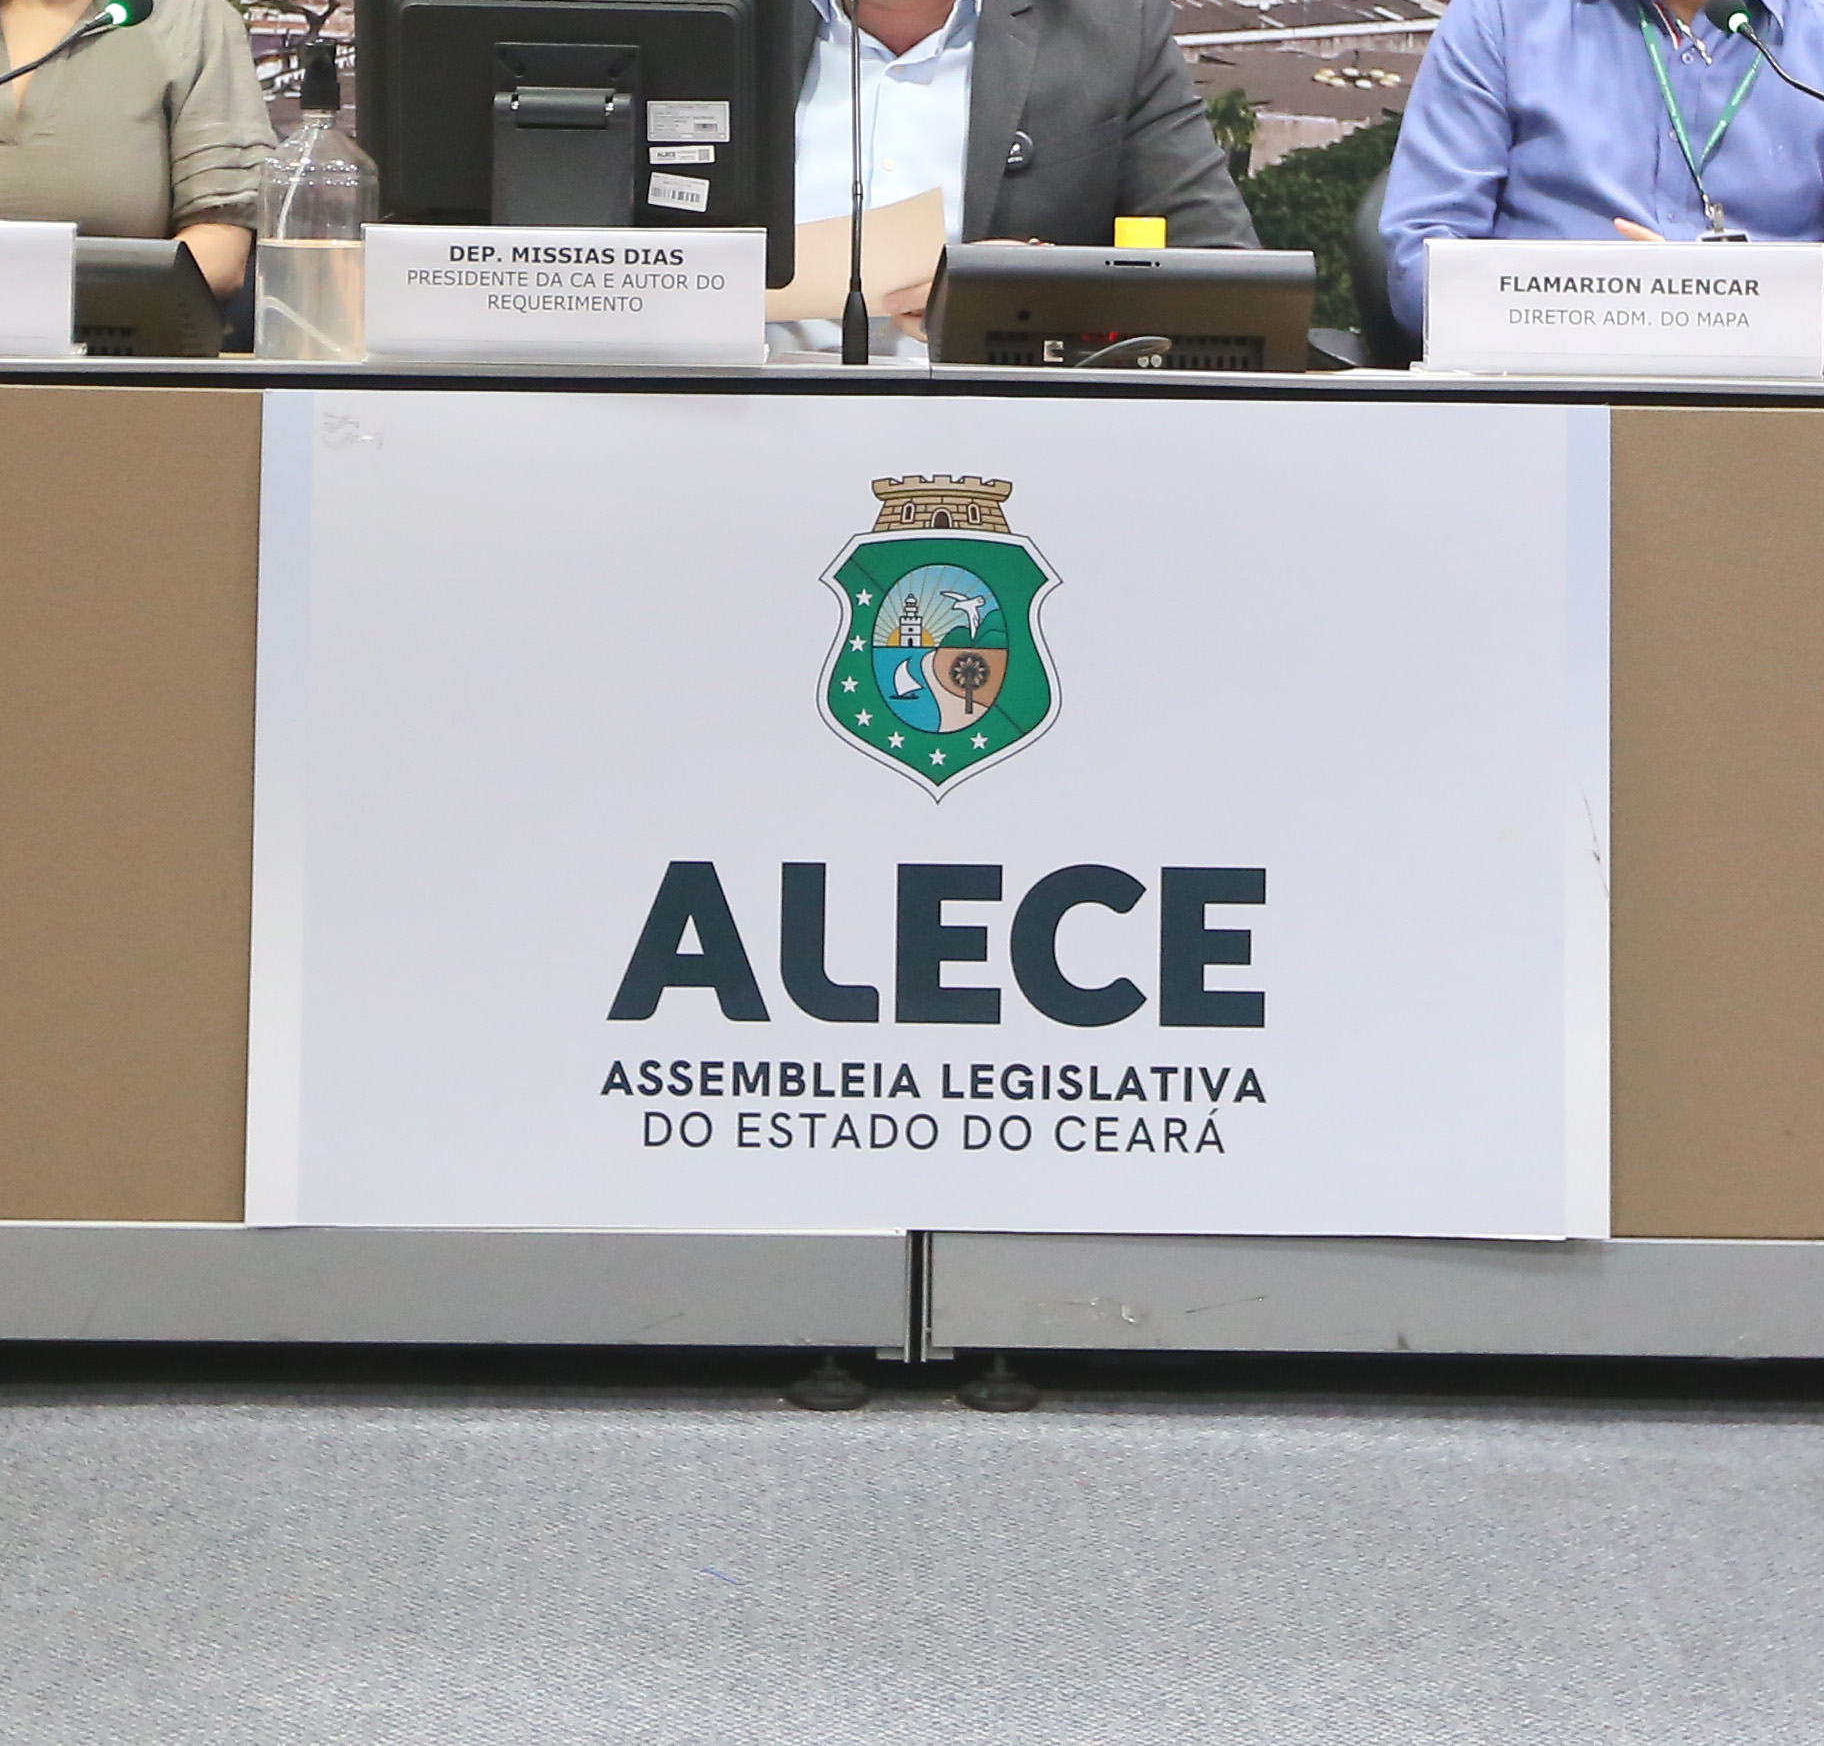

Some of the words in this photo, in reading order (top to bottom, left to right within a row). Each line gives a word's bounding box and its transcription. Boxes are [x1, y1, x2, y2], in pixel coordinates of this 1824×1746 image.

[450, 246, 502, 262] DEP.
[512, 247, 615, 264] MISSIAS
[625, 249, 683, 266] DIAS
[408, 270, 528, 287] PRESIDENTE
[536, 272, 563, 287] DA
[570, 272, 596, 288] CA
[604, 273, 614, 288] E
[621, 273, 688, 289] AUTOR
[697, 274, 725, 290] DO
[1500, 276, 1641, 294] FLAMARION
[1651, 278, 1759, 296] ALENCAR
[488, 294, 643, 314] REQUERIMENTO
[1509, 309, 1596, 325] DIRETOR
[1603, 310, 1651, 326] ADM.
[1661, 311, 1689, 327] DO
[1697, 312, 1749, 327] MAPA
[606, 861, 1266, 1028] ALECE
[601, 1060, 921, 1098] ASSEMBLEIA
[942, 1063, 1266, 1103] LEGISLATIVA
[644, 1111, 712, 1148] DO
[738, 1112, 938, 1150] ESTADO
[964, 1115, 1032, 1151] DO
[1055, 1108, 1225, 1154] CEARÁ
